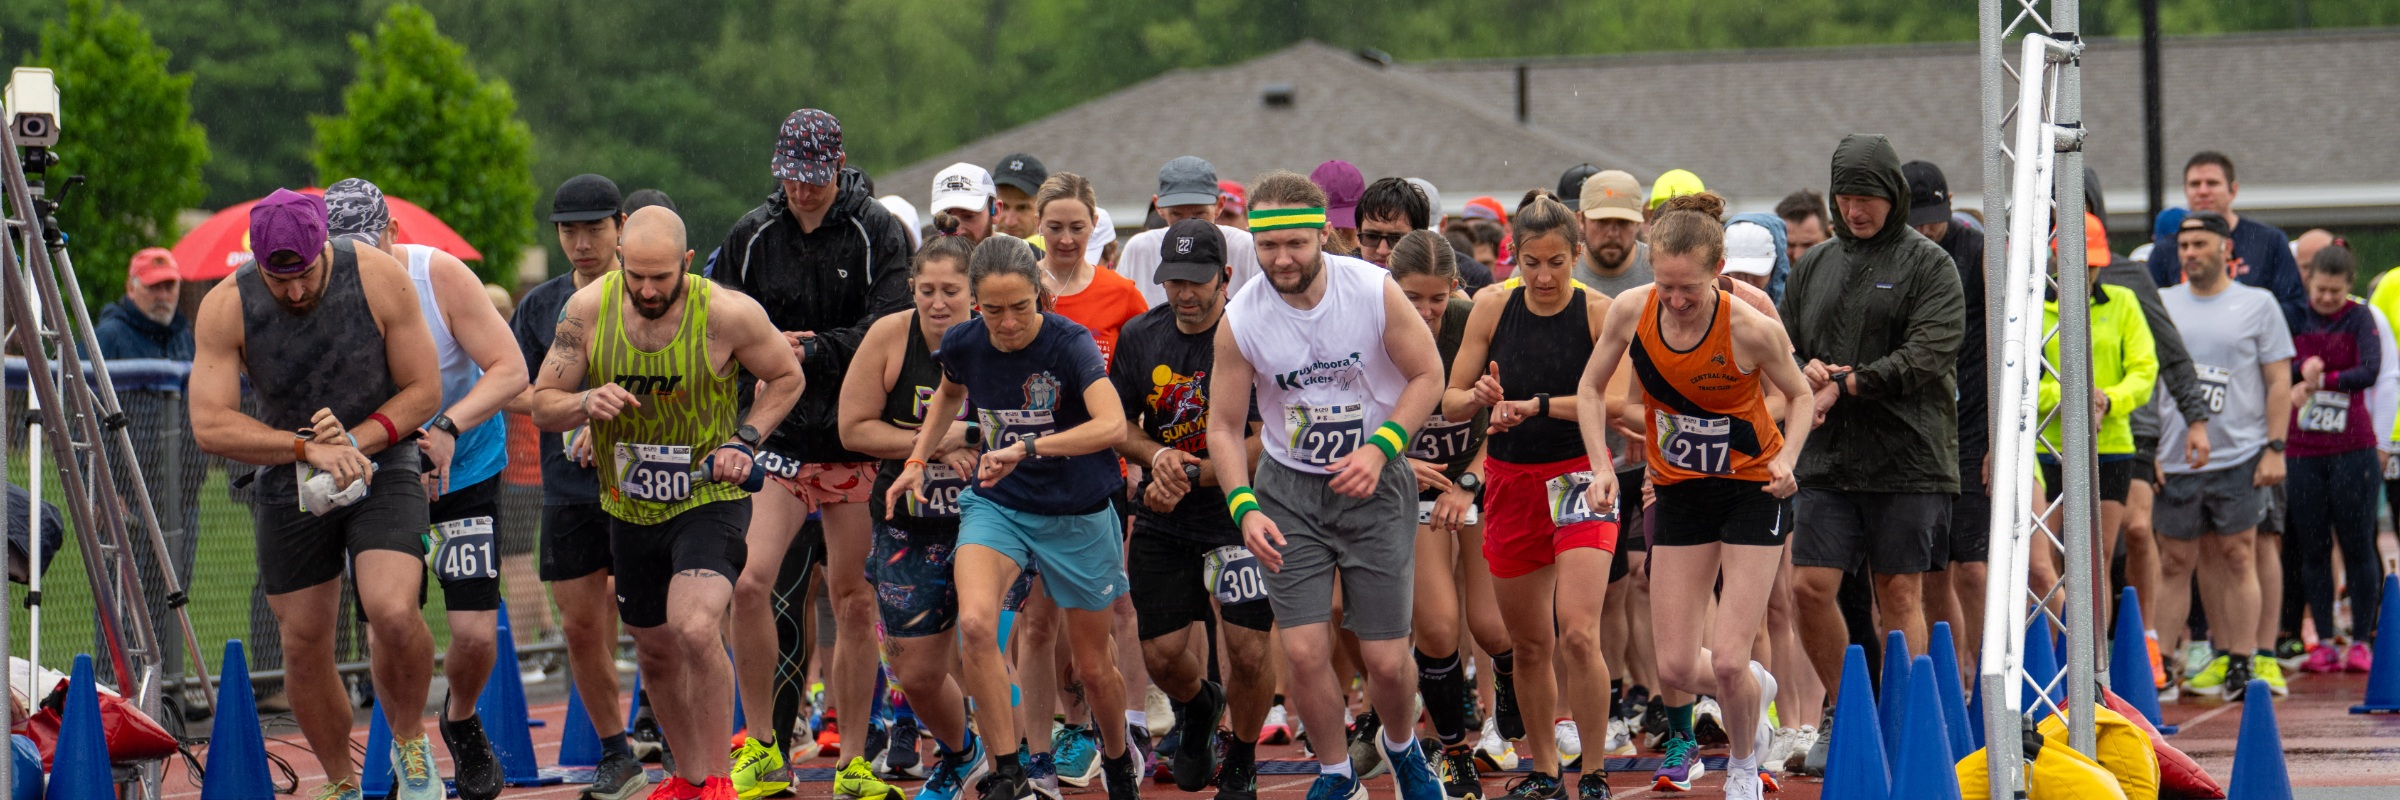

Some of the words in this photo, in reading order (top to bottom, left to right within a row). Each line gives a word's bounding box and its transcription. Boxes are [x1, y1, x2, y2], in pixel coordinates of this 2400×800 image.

[1178, 240, 1190, 252] 22
[1690, 373, 1721, 384] CENTRAL
[1722, 373, 1738, 383] PARK
[2309, 406, 2347, 433] 284
[1308, 427, 1362, 464] 227
[1421, 427, 1471, 459] 317
[1675, 439, 1729, 472] 217
[637, 468, 690, 501] 380
[1573, 490, 1620, 519] 44
[445, 541, 492, 578] 461
